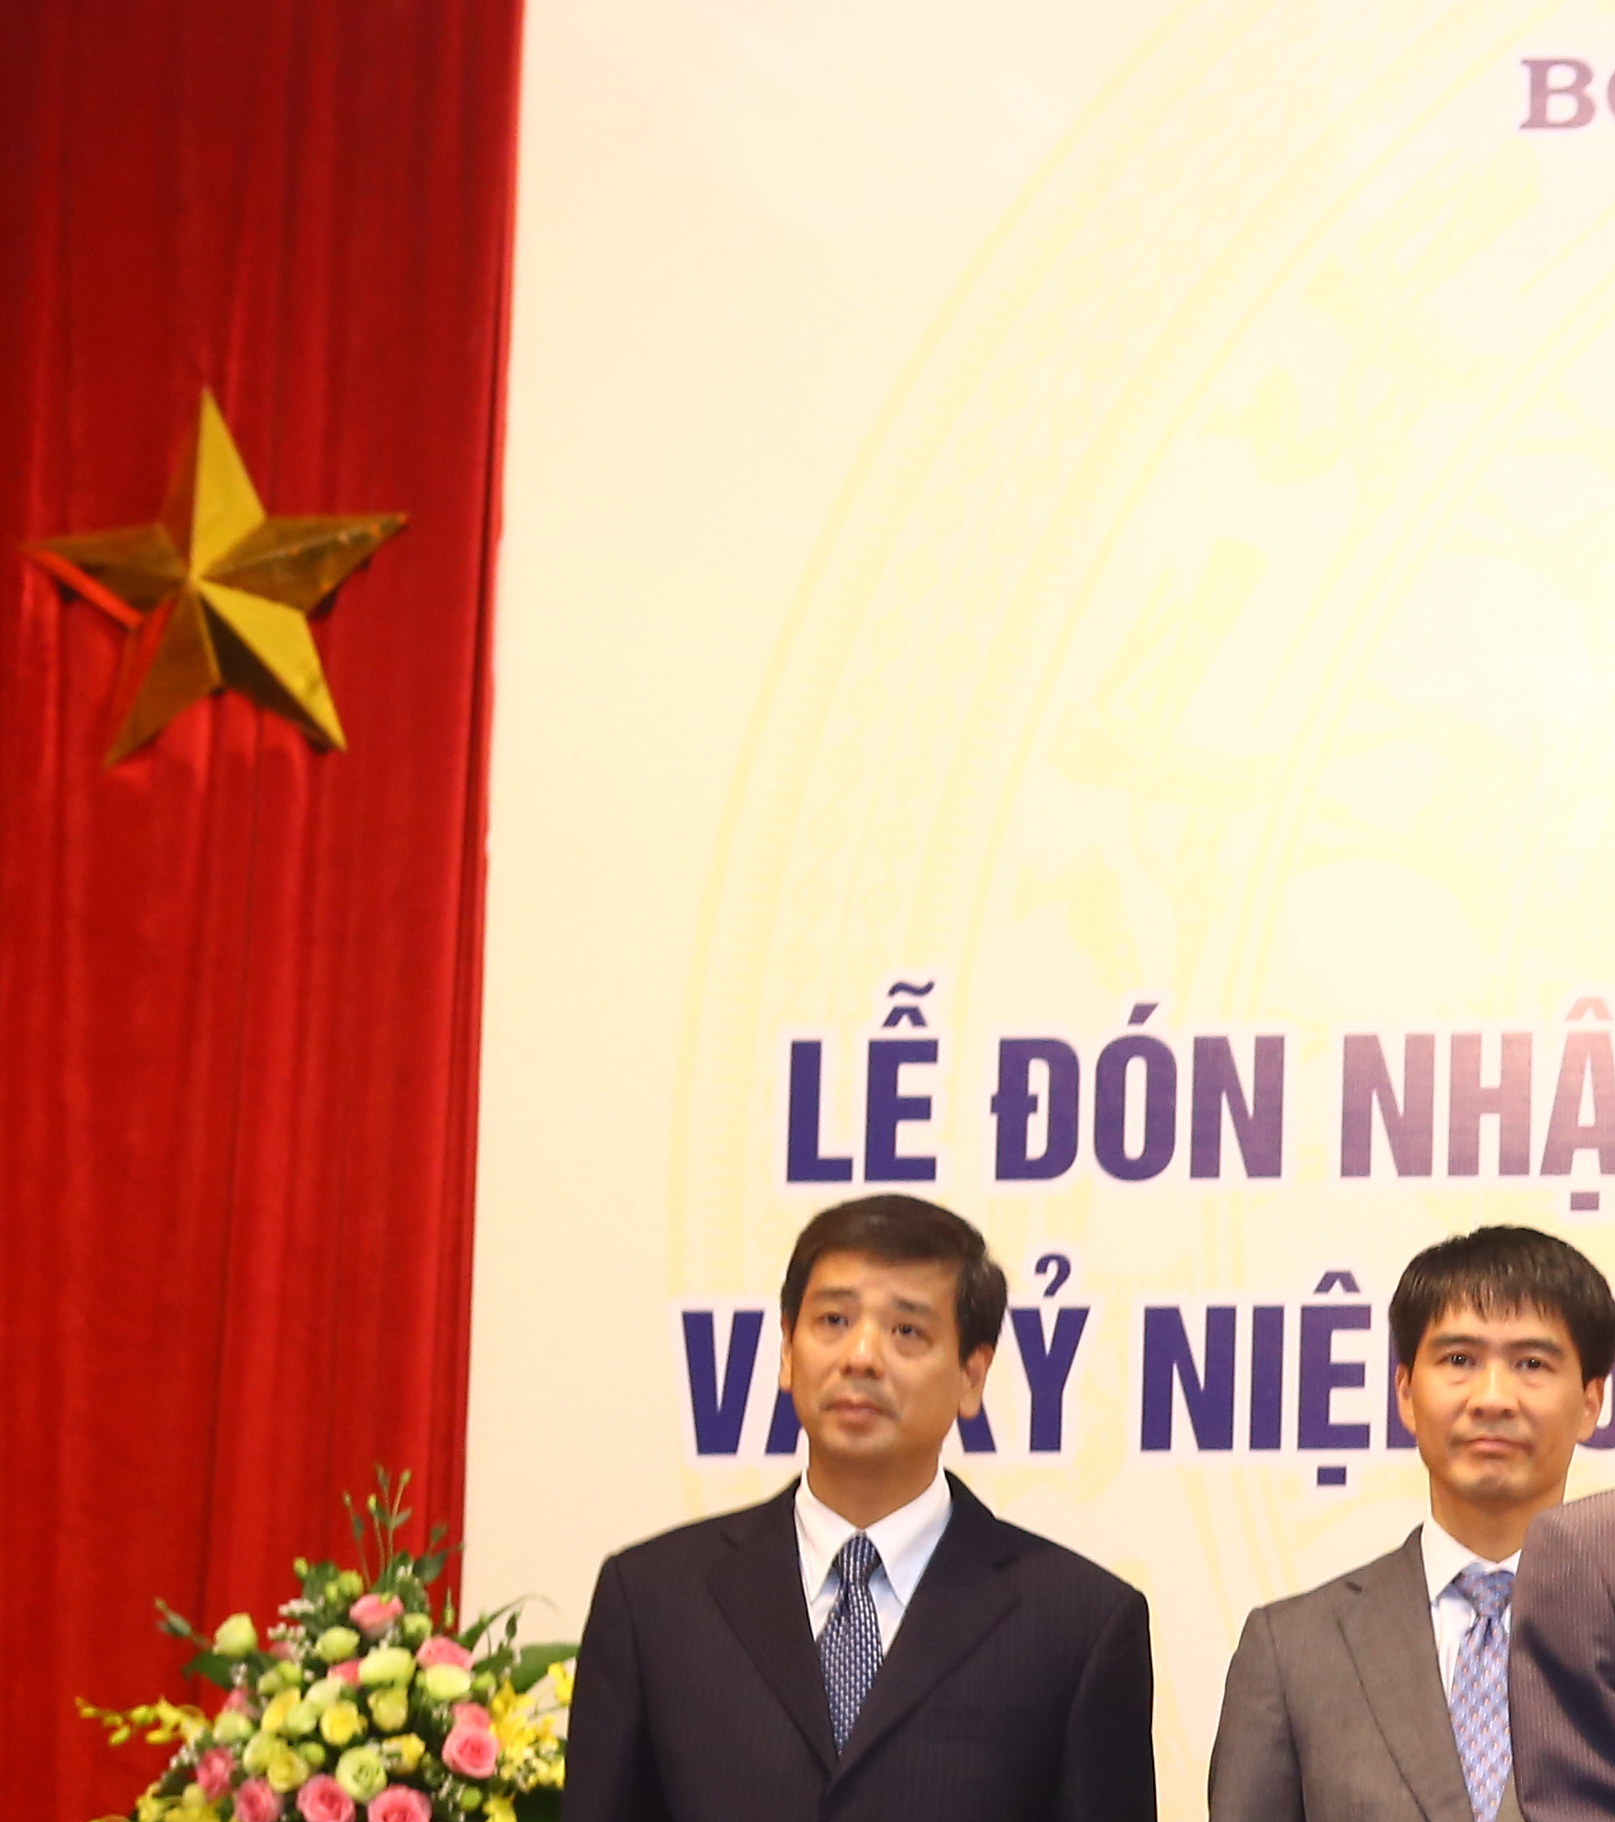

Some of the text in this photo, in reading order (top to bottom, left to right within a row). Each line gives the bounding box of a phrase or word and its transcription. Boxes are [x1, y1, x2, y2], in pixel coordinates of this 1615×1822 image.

[785, 981, 941, 1187] LỄ
[990, 1002, 1286, 1185] ĐÓN
[681, 1308, 803, 1458] V
[957, 1252, 1092, 1455] Ỷ
[1139, 1270, 1418, 1488] NIỆ
